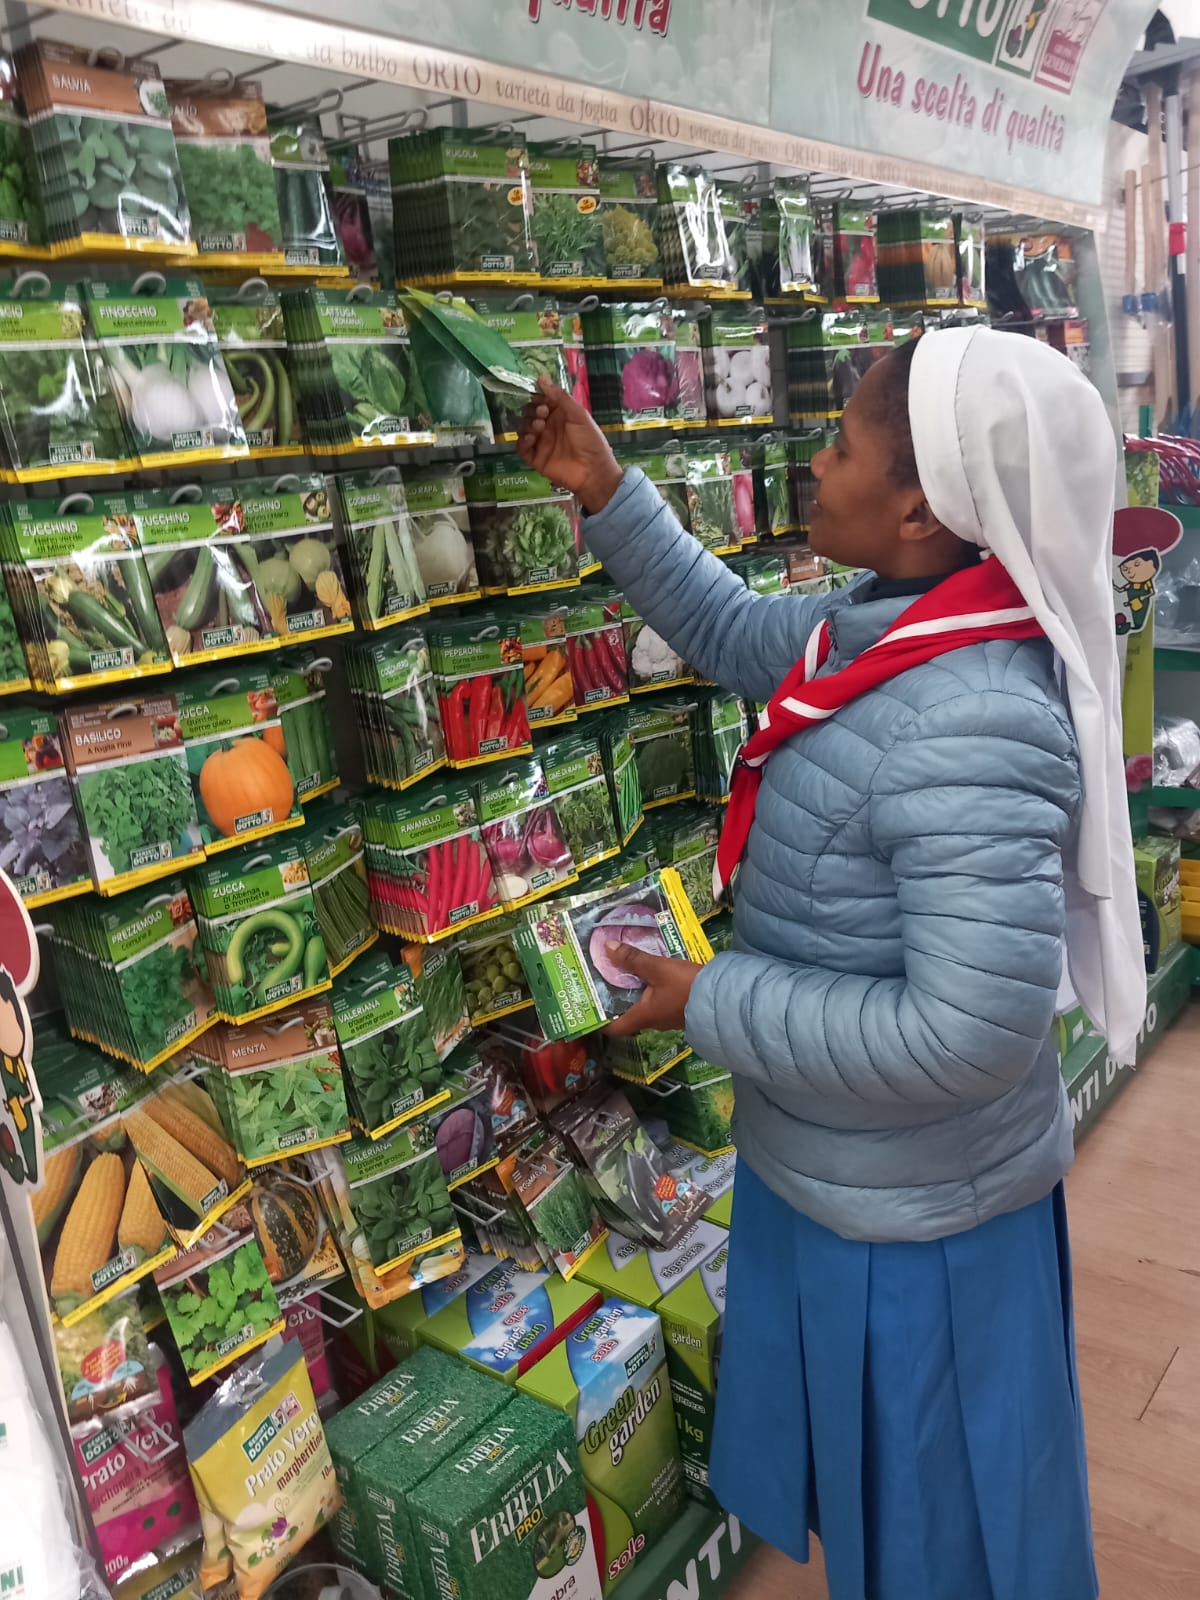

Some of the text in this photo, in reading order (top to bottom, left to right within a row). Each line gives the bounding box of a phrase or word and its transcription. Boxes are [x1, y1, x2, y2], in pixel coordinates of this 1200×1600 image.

[52, 74, 92, 94] SALVIA
[341, 34, 398, 78] bulbo
[412, 55, 482, 97] ORTO
[496, 78, 551, 109] varietà
[556, 83, 576, 114] da
[580, 88, 618, 124] foglia
[630, 103, 680, 138] ORTO
[857, 41, 1065, 153] Una scelta di qualità
[99, 305, 157, 320] FINOCCHIO
[320, 307, 356, 318] LATTUGA
[487, 318, 515, 328] ATTUGA
[174, 438, 201, 448] DOTTO
[497, 477, 529, 487] LATTUGA
[22, 520, 78, 537] ZUCCHINO
[140, 511, 190, 526] ZUCCHINO
[288, 620, 314, 630] DOTTO
[204, 635, 233, 647] DOTTO
[444, 645, 483, 658] PEPERONE
[92, 658, 121, 669] DOTTO
[178, 705, 210, 720] ZUCCA
[75, 728, 122, 746] BASILICO
[479, 744, 500, 752] DOTTO
[236, 819, 262, 831] DOTTO
[401, 814, 441, 833] RAVANELLO
[133, 853, 160, 866] DOTTO
[212, 882, 246, 898] ZUCCA
[231, 888, 261, 902] Albenga
[231, 892, 270, 908] Trombetta
[111, 911, 163, 945] PREZZEMOLO
[666, 924, 682, 952] DOTTO
[555, 952, 570, 980] ROSSO
[266, 987, 291, 1001] DOTTO
[338, 999, 381, 1023] VALERIANA
[558, 990, 577, 1028] CAVOLO
[232, 1043, 267, 1058] MENTA
[394, 1100, 415, 1113] DOTTO
[280, 1136, 306, 1147] DOTTO
[347, 1143, 392, 1165] VALERIANA
[400, 1237, 423, 1251] DOTTO
[661, 1242, 705, 1279] rigenera
[705, 1248, 729, 1273] Green
[93, 1262, 123, 1287] DOTTO
[473, 1271, 502, 1295] Green
[492, 1263, 522, 1292] garden
[489, 1291, 515, 1313] sole
[503, 1304, 530, 1326] sole
[593, 1307, 625, 1340] garden
[518, 1323, 547, 1351] Green
[572, 1316, 602, 1344] Green
[671, 1331, 702, 1348] garden
[218, 1337, 244, 1356] DOTTO
[494, 1325, 527, 1360] garden
[591, 1339, 619, 1363] sole
[627, 1351, 650, 1378] DOTTO
[628, 1346, 648, 1366] SEMENTI
[357, 1372, 416, 1418] ERBELLA
[386, 1389, 421, 1418] penombra
[388, 1391, 404, 1405] PRO
[400, 1397, 460, 1445] ERBELLA
[430, 1415, 466, 1446] penombra
[432, 1417, 449, 1431] PRO
[583, 1384, 637, 1455] Green
[608, 1377, 661, 1467] garden
[684, 1419, 705, 1443] kg
[85, 1430, 119, 1461] DOTTO
[124, 1420, 173, 1457] Vero
[248, 1423, 270, 1449] SEMENTI
[248, 1428, 275, 1461] DOTTO
[244, 1411, 319, 1498] Prato Vero
[276, 1431, 324, 1491] margheritine
[454, 1425, 515, 1475] ERBELLA
[486, 1443, 522, 1475] penombra
[488, 1445, 504, 1461] PRO
[501, 1460, 543, 1504] TAPPETO ERBOSO
[469, 1448, 575, 1565] ERBELLA
[515, 1508, 543, 1544] PRO
[608, 1533, 646, 1581] sole
